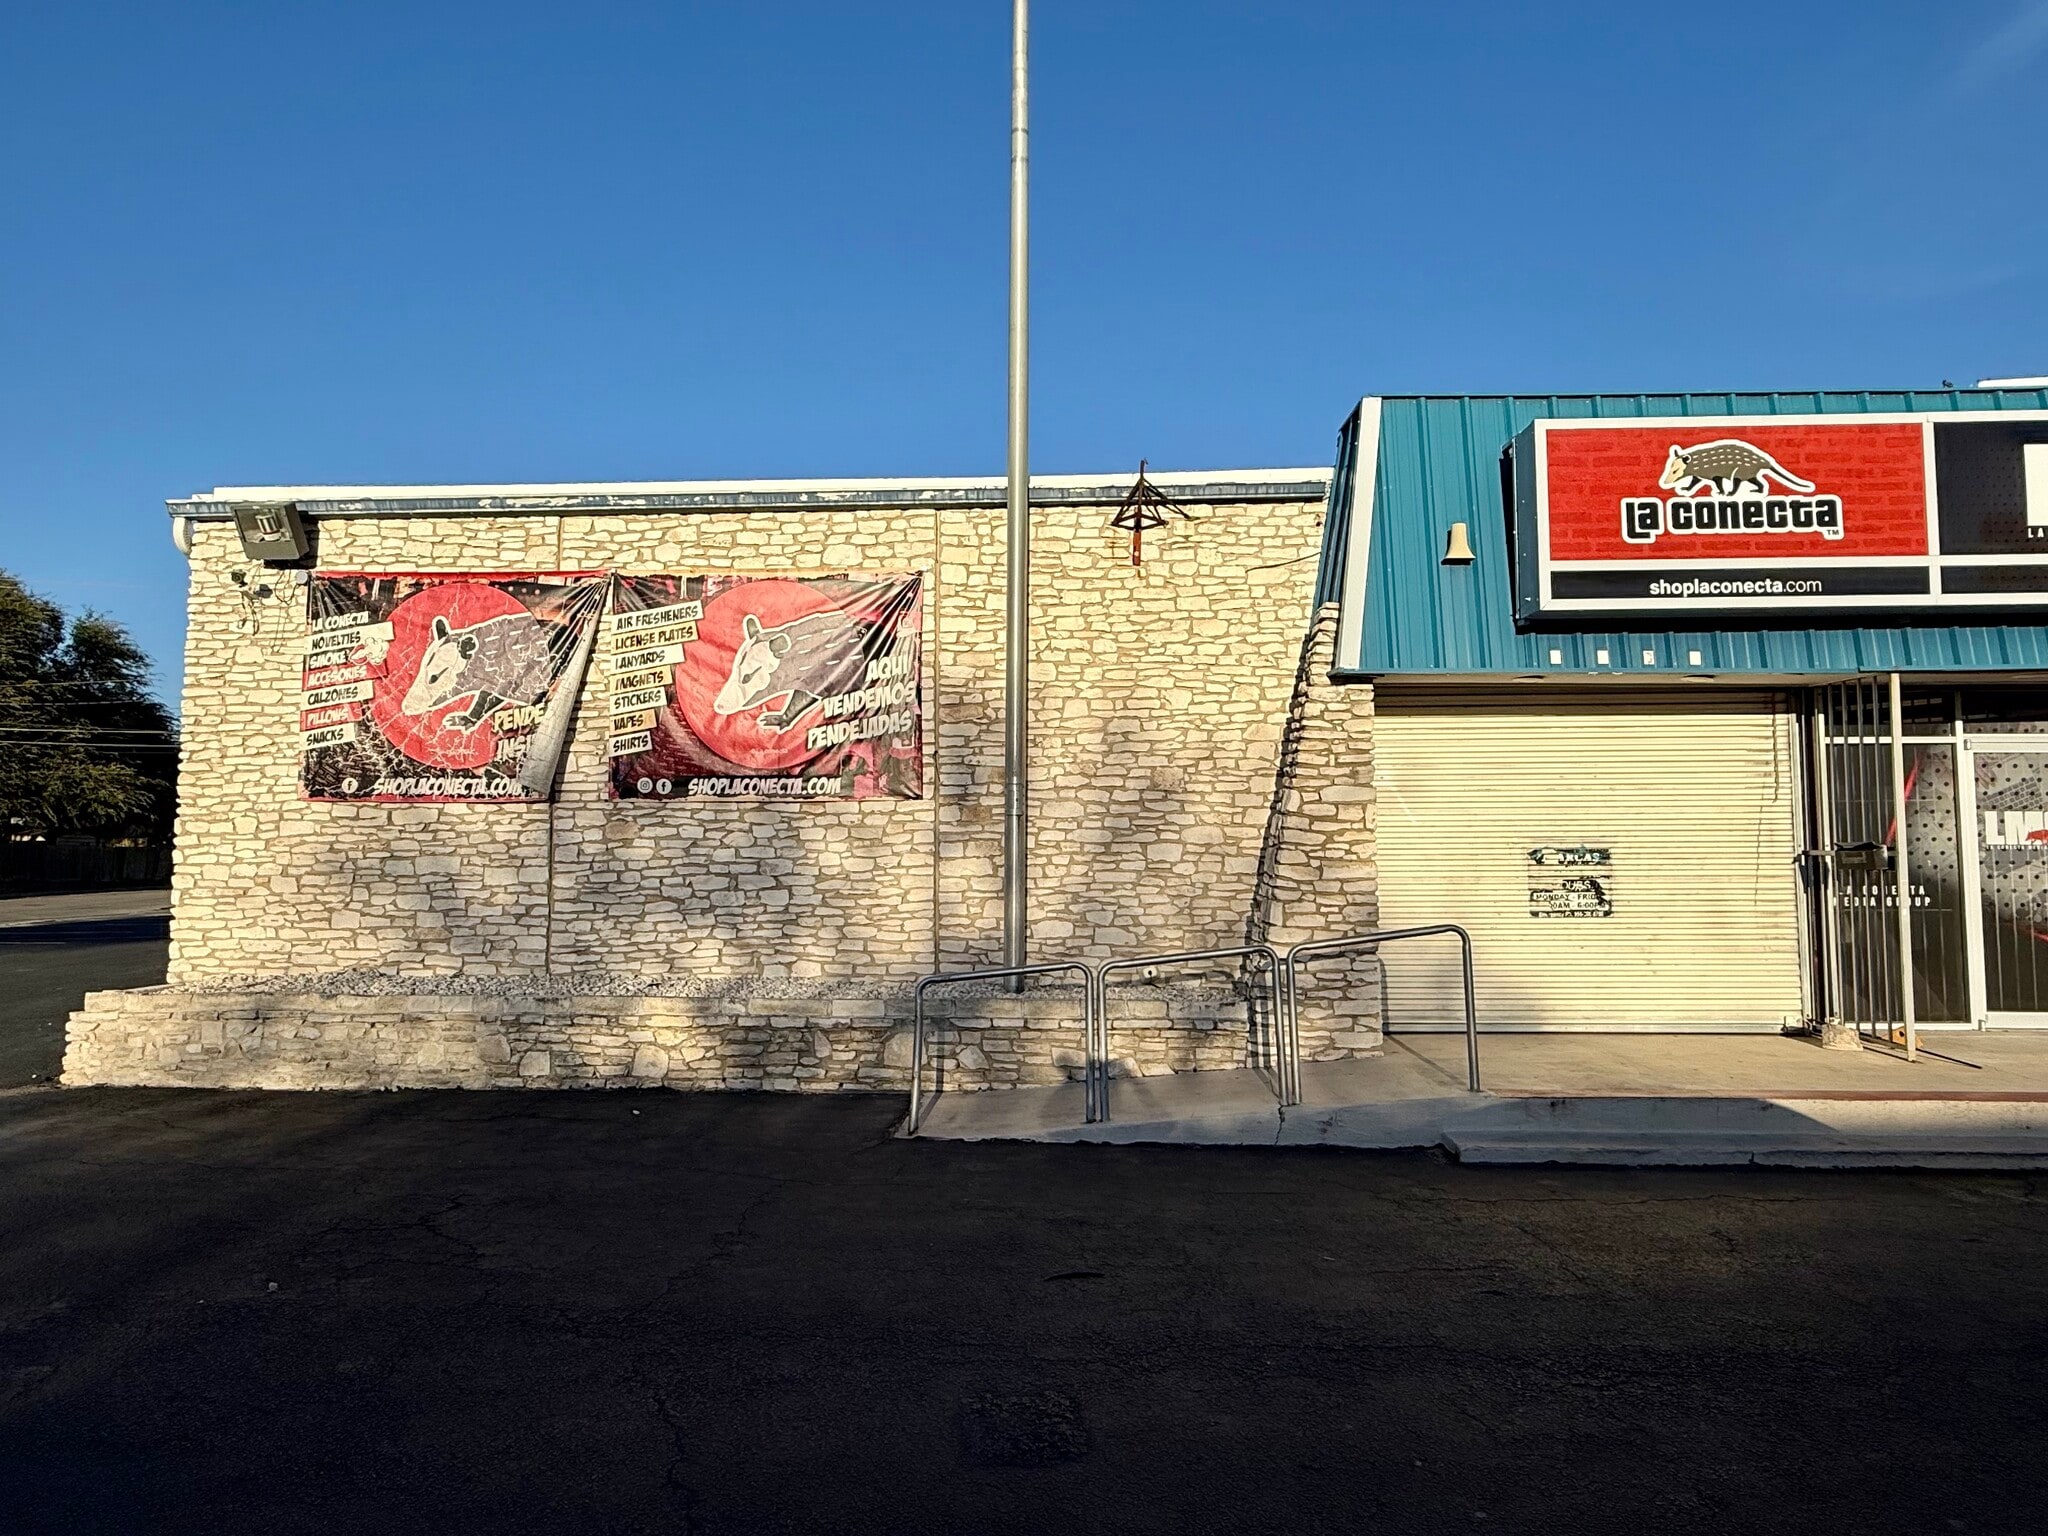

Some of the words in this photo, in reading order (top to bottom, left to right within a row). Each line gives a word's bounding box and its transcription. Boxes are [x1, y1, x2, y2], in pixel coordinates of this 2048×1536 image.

[1649, 578, 1823, 598] shoplaconecta.com
[312, 617, 323, 632] LA
[324, 611, 369, 630] CONECTA
[616, 615, 633, 631] AIR
[635, 605, 699, 627] FRESHENERS
[312, 630, 361, 651] NOVELTIES
[615, 632, 656, 650] LICENSE
[658, 625, 694, 643] PLATES
[310, 651, 348, 669] SMOKE
[615, 650, 666, 670] LANYARDS
[615, 670, 664, 691] MAGNETS
[307, 686, 359, 705] CALZONES
[614, 690, 662, 710] STICKERS
[823, 680, 918, 719] VENDEMOS
[306, 707, 349, 727] PILLOWS
[493, 702, 545, 733] PENDE
[613, 713, 644, 731] VAPES
[306, 728, 344, 746] SNACKS
[806, 710, 913, 750] PENDEJADAS
[612, 734, 649, 753] SHIRTS
[687, 776, 842, 796] SHOPLACONECTA.COM
[1984, 810, 2048, 845] LM
[1535, 892, 1570, 902] MONDAY
